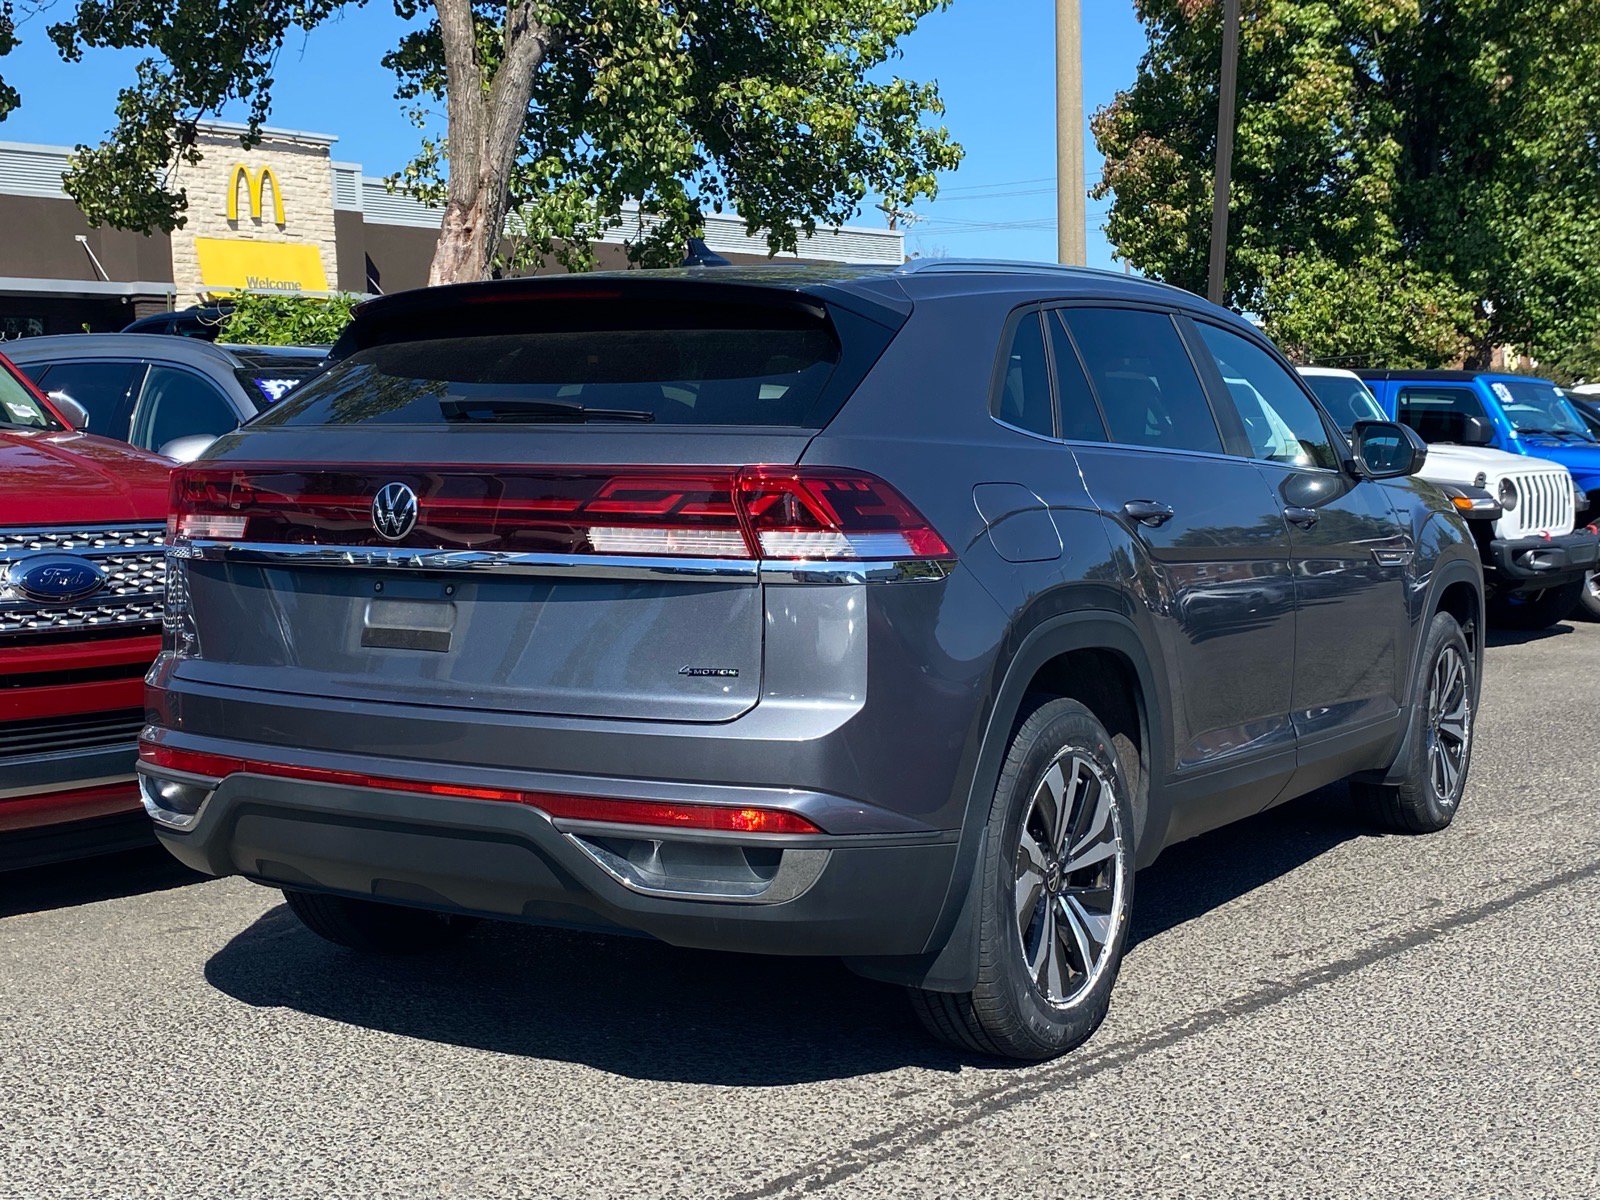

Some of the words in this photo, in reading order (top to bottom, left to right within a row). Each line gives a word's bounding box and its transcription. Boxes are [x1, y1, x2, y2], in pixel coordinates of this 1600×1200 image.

[246, 275, 302, 290] Welcome
[341, 551, 448, 566] ATLAS
[41, 567, 84, 584] Ford
[678, 664, 738, 676] 4MOTION
